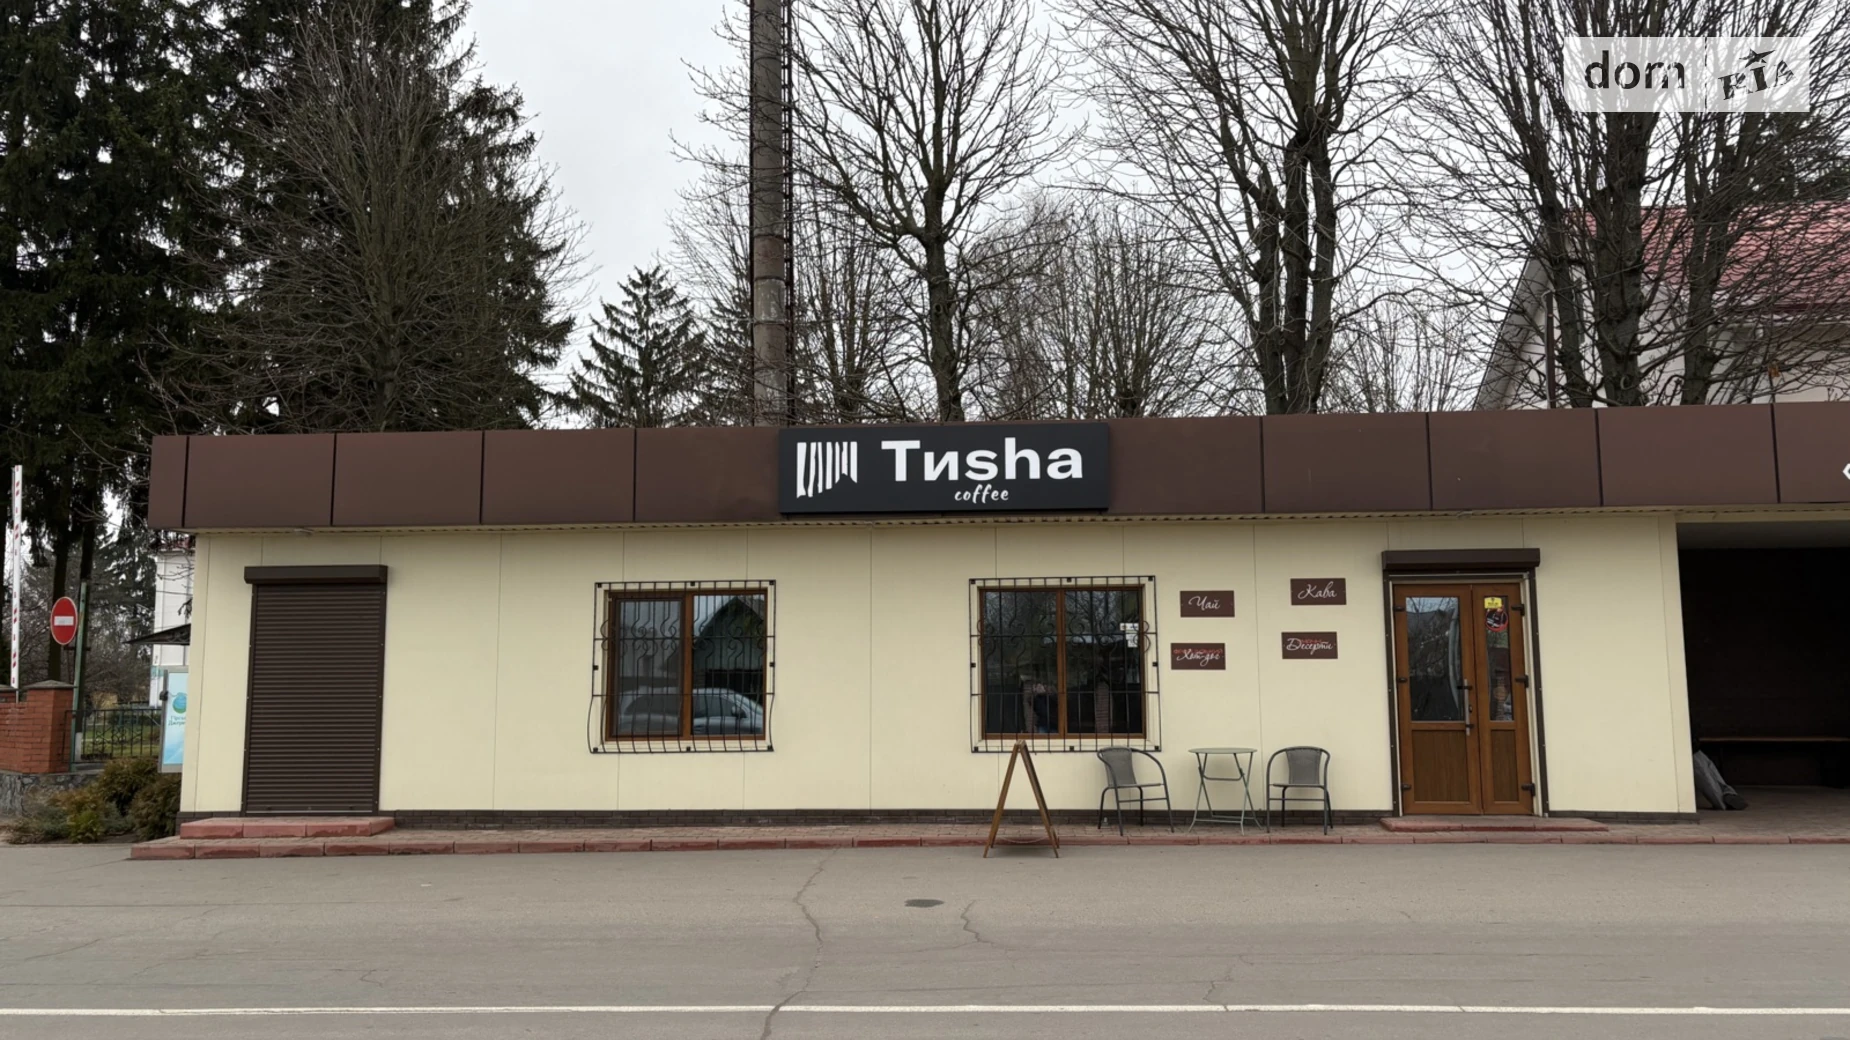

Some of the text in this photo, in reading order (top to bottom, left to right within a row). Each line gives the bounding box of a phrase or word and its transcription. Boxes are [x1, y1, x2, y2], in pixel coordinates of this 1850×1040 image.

[954, 484, 1009, 504] coffee
[1297, 580, 1338, 600] Кава
[1188, 595, 1221, 611] Чай
[1286, 637, 1334, 655] Десерти
